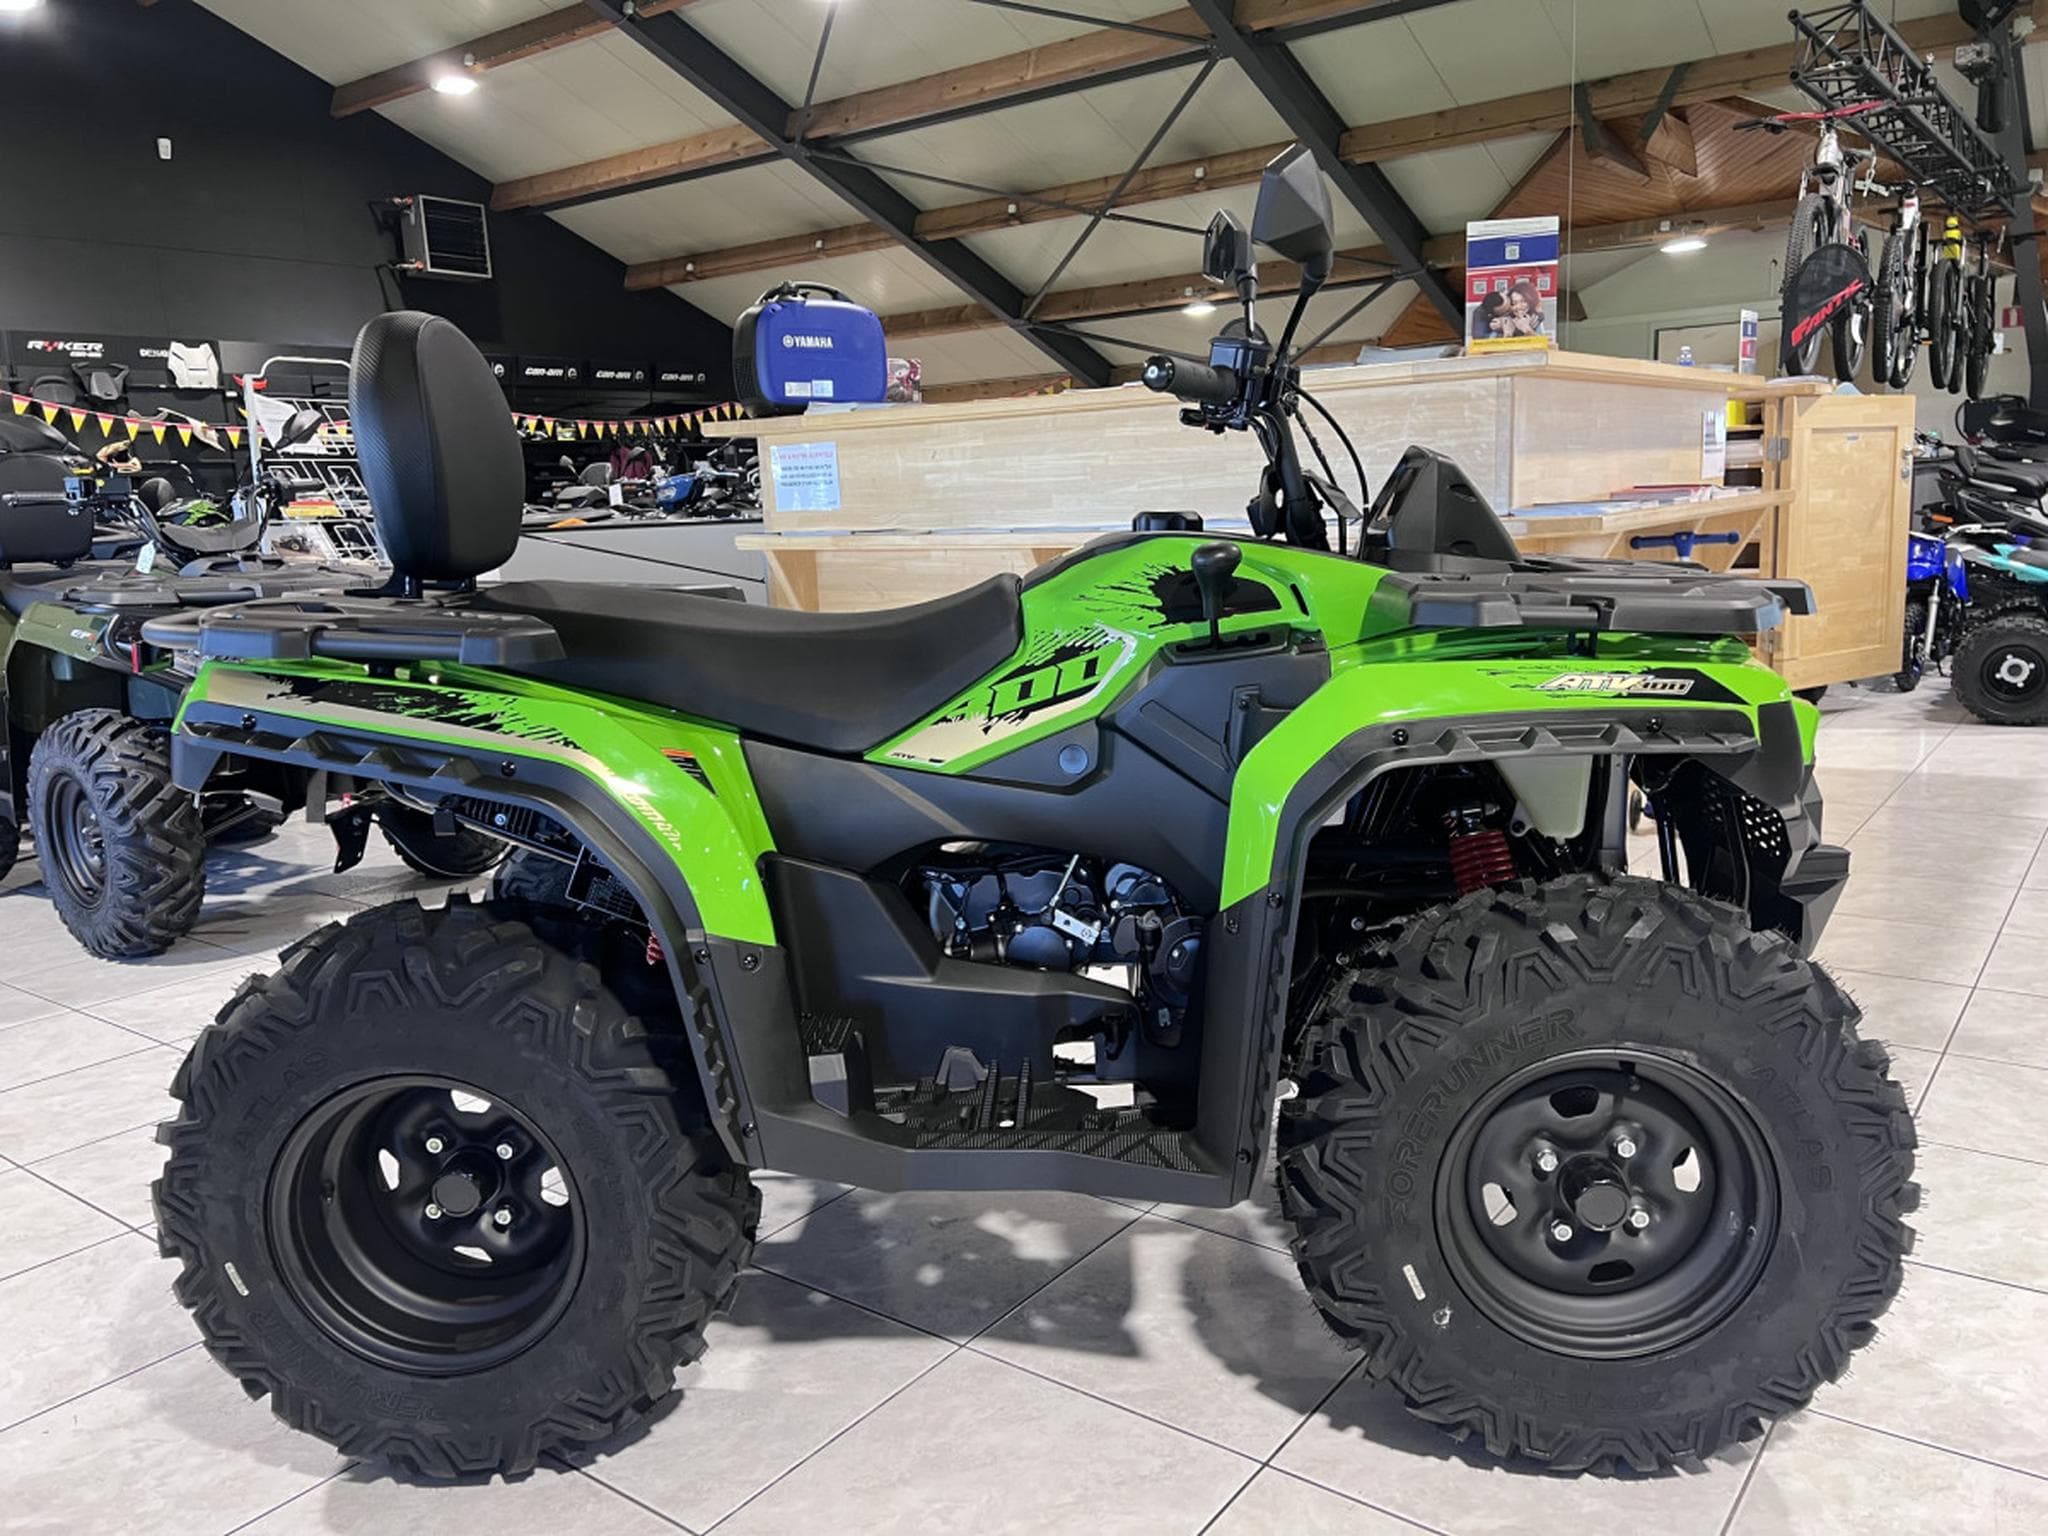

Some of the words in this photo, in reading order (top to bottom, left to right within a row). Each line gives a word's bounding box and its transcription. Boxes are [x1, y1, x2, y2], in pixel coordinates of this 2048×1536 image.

[27, 340, 104, 351] RYKER
[794, 335, 833, 348] YAMAHA
[1384, 1007, 1586, 1227] FORERUNNER
